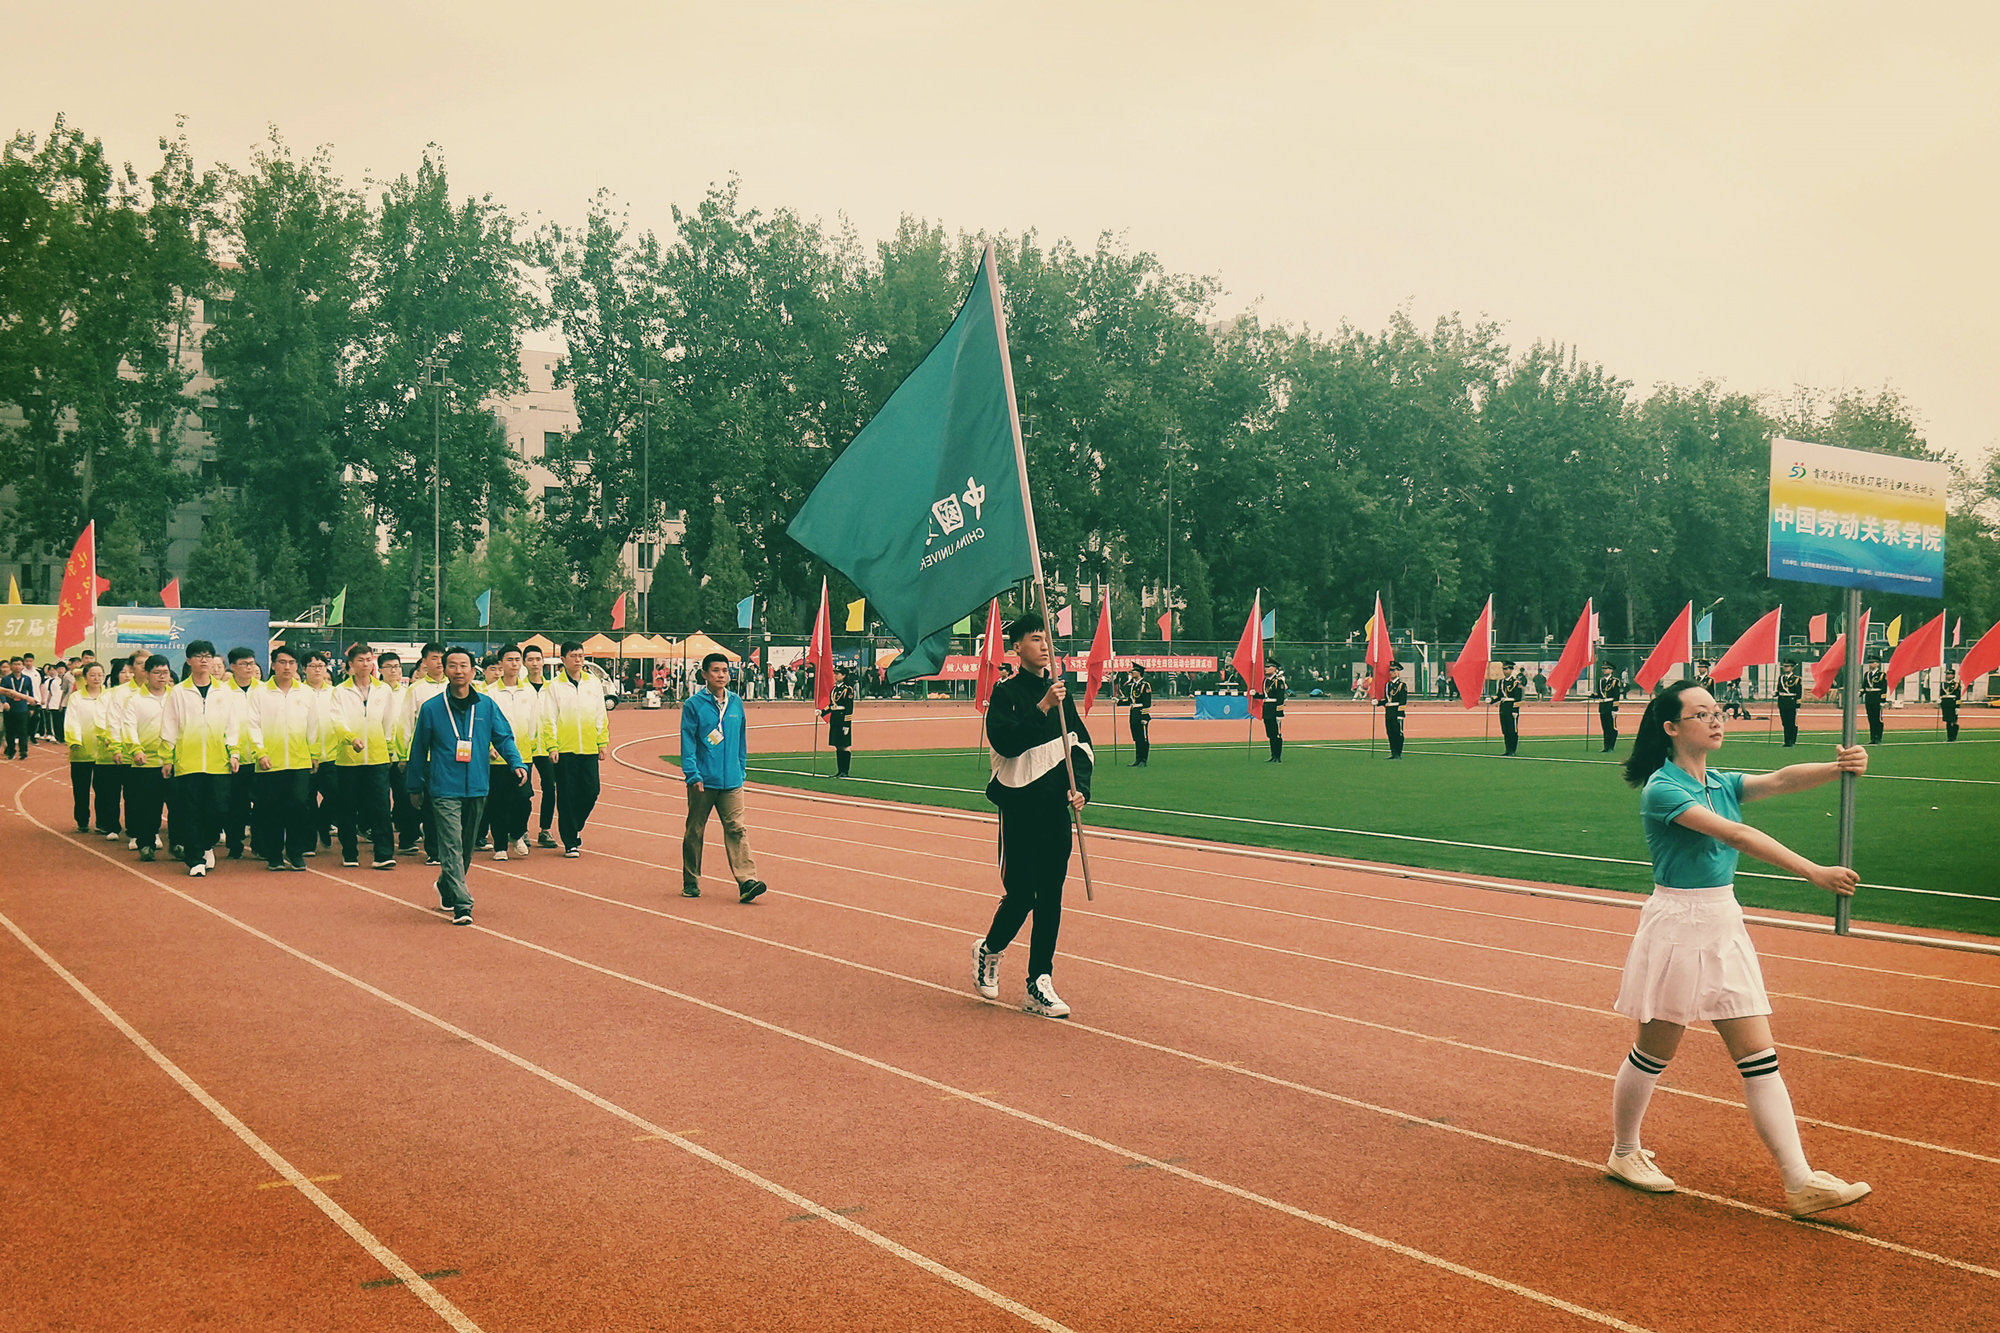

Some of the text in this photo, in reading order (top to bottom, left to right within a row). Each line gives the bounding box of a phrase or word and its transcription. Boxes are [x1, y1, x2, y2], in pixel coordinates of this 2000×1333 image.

[1774, 503, 1943, 552] 中国劳动关系学院
